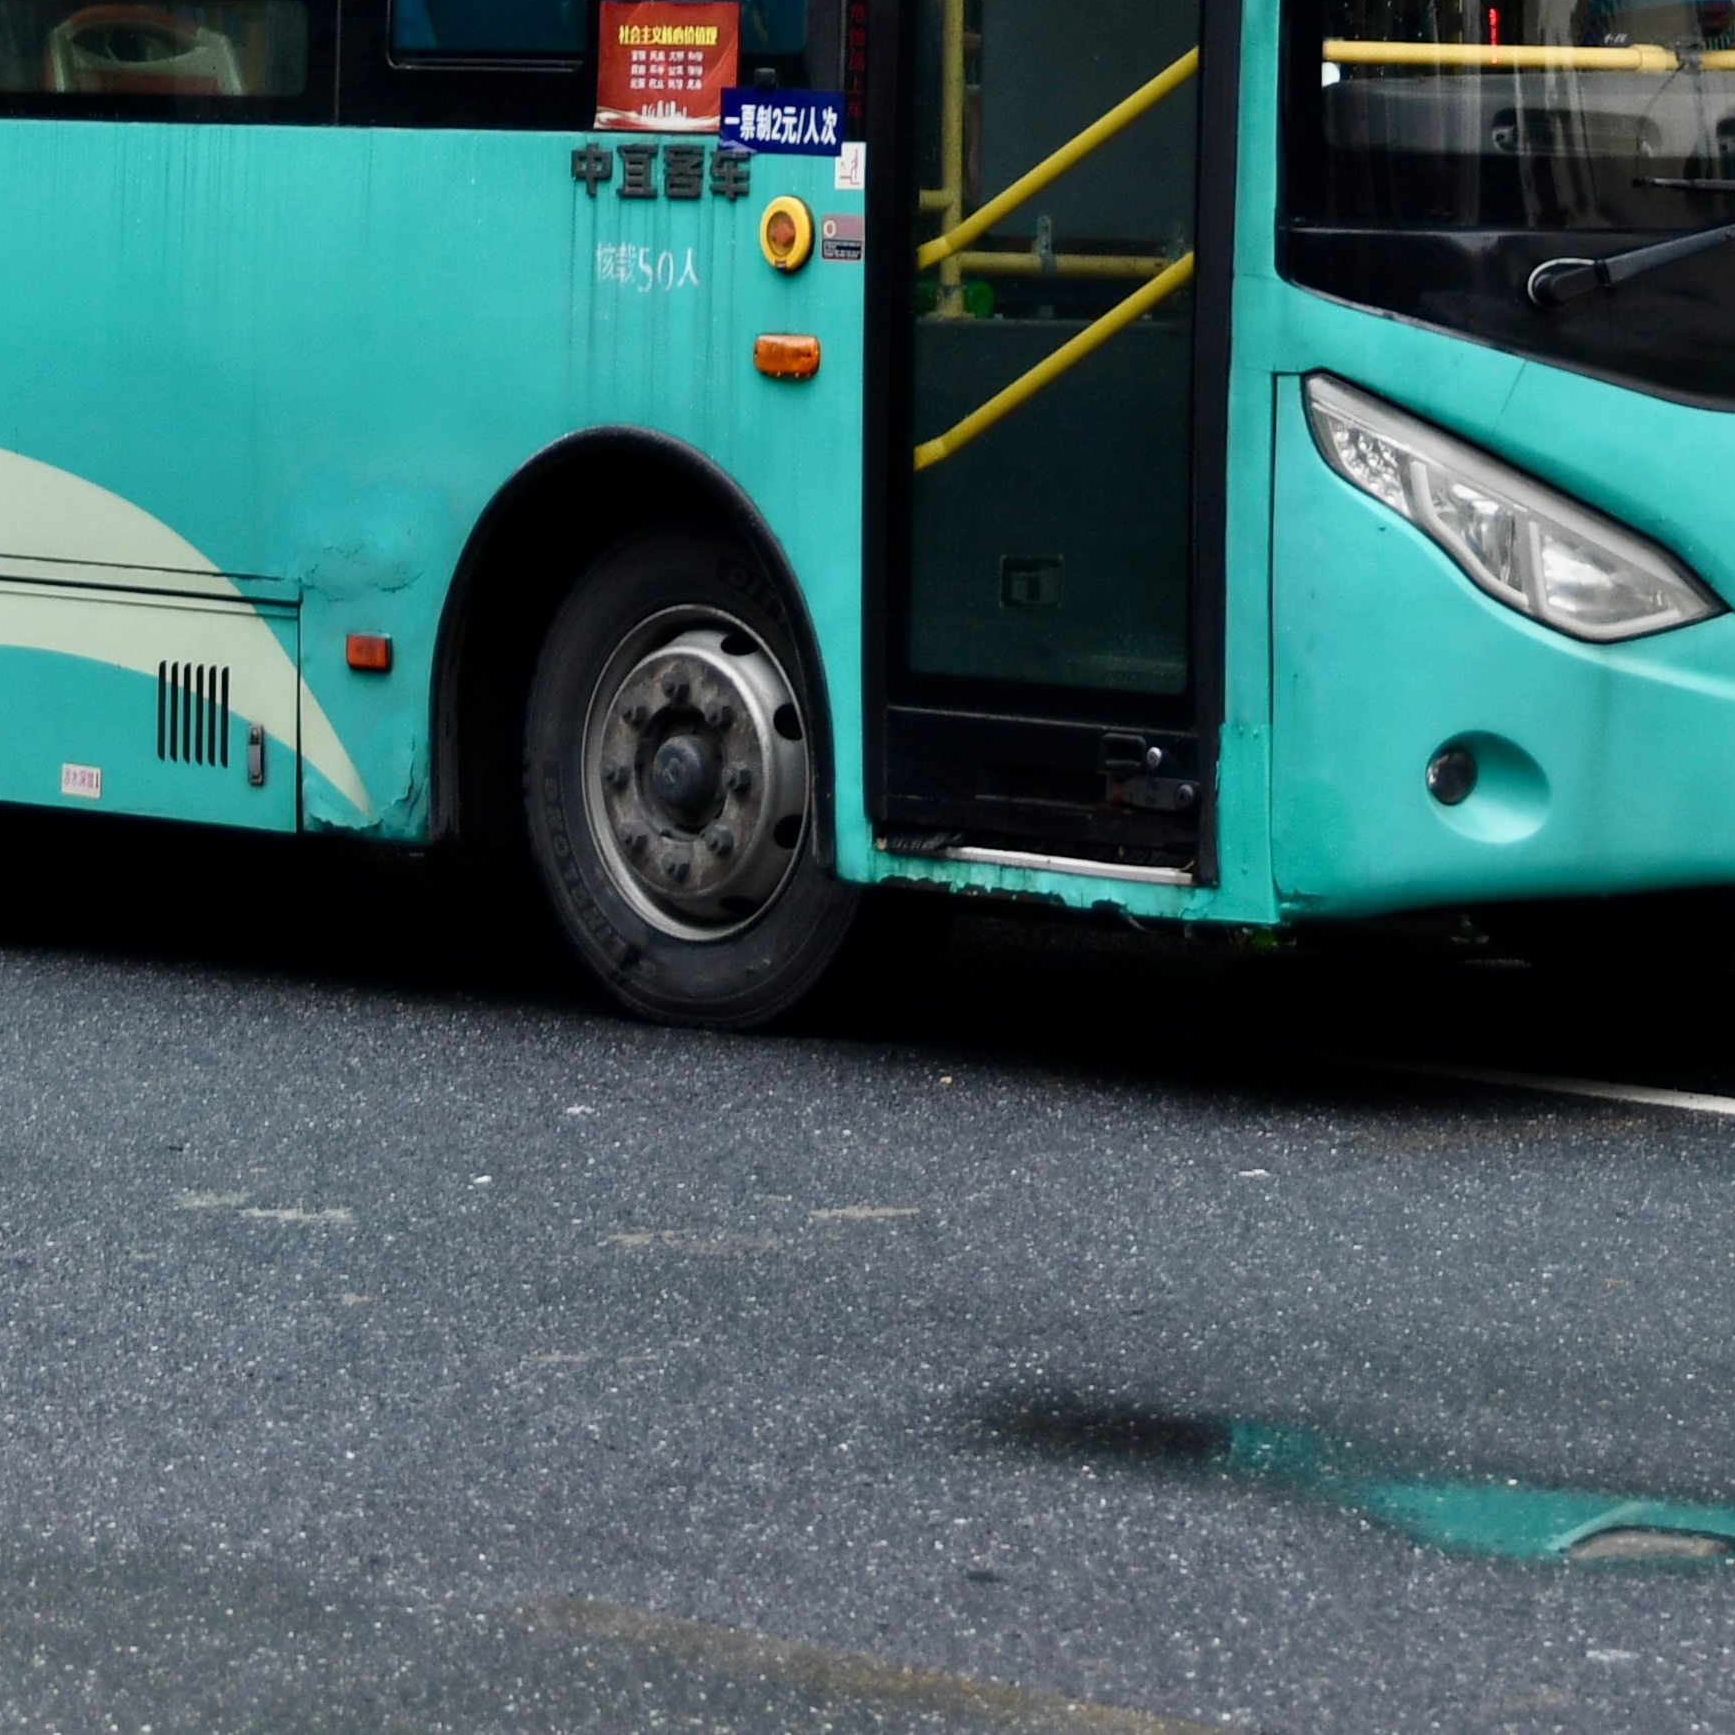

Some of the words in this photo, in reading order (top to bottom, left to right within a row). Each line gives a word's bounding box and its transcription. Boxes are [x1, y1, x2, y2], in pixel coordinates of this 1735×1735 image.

[724, 104, 838, 146] 一票制2元/人次
